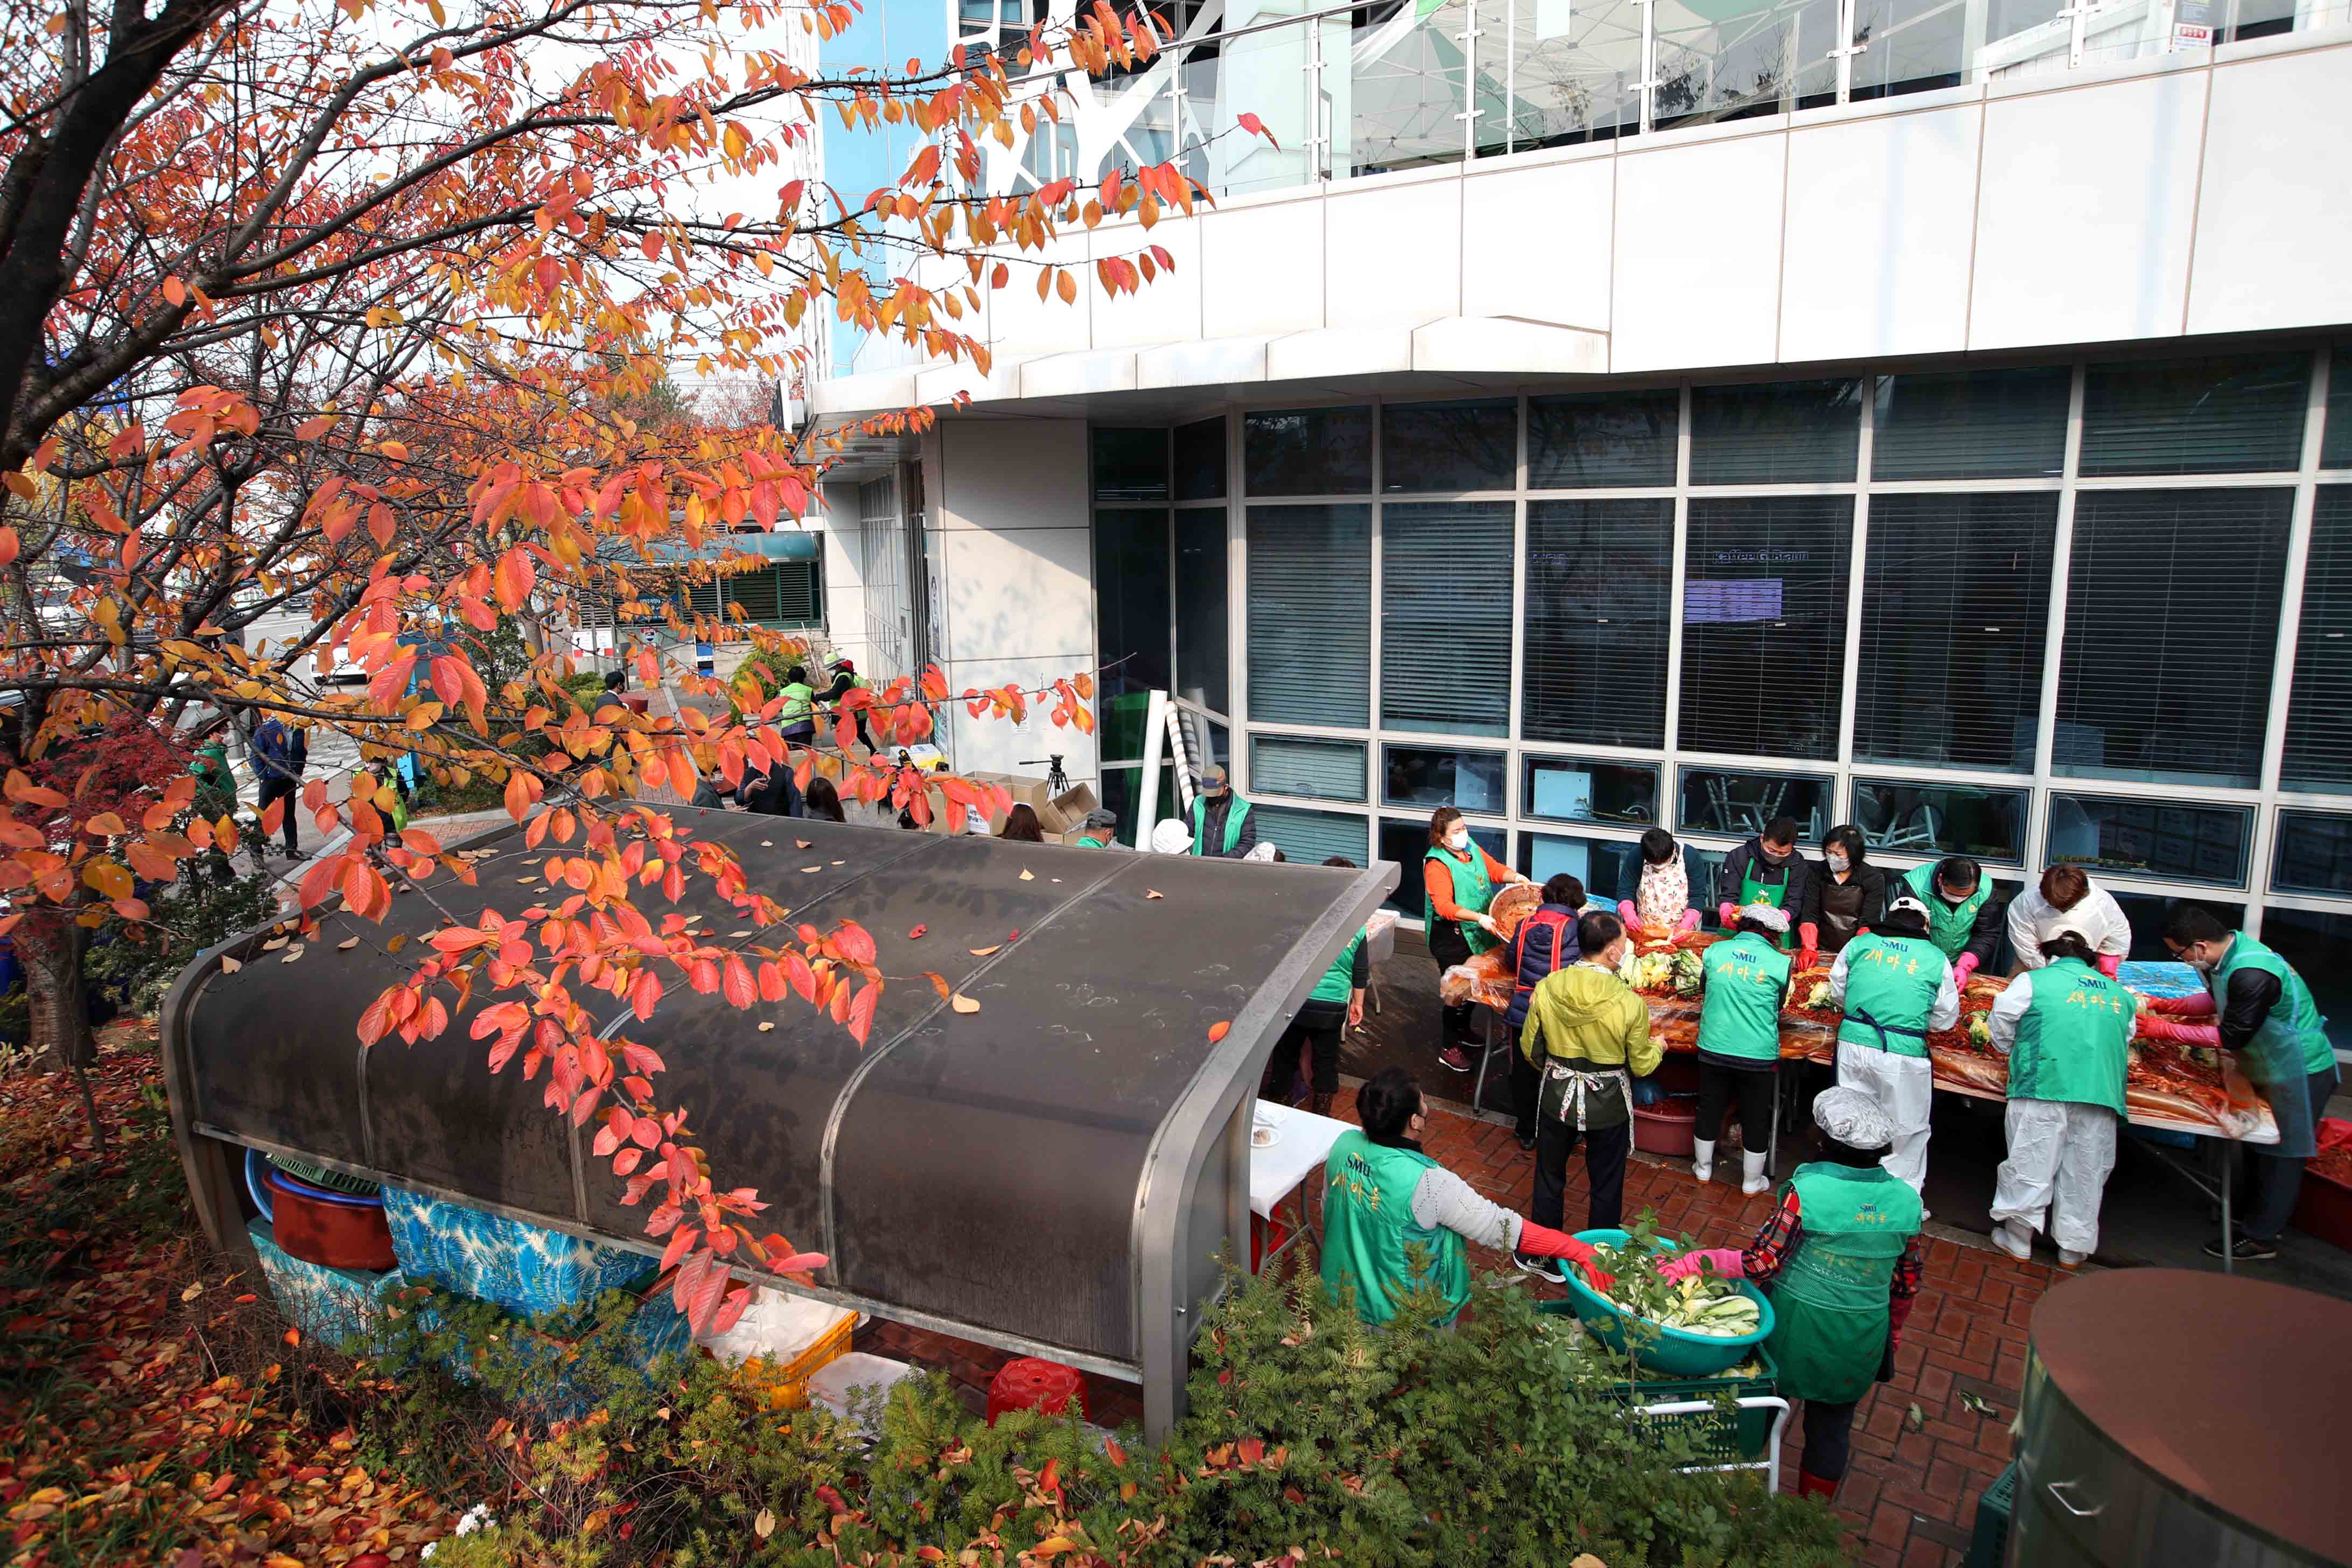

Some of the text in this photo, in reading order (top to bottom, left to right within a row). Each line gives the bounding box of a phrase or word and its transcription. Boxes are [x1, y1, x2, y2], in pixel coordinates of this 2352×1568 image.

[1732, 951, 1756, 963] SMU
[1880, 939, 1908, 952] SMU
[1865, 948, 1920, 974] 새마을
[1717, 961, 1767, 985] 새마을
[2078, 977, 2106, 989] SMU
[2067, 991, 2122, 1014] 새마을
[1346, 1154, 1370, 1177] SMU
[1332, 1171, 1381, 1211] 새마을
